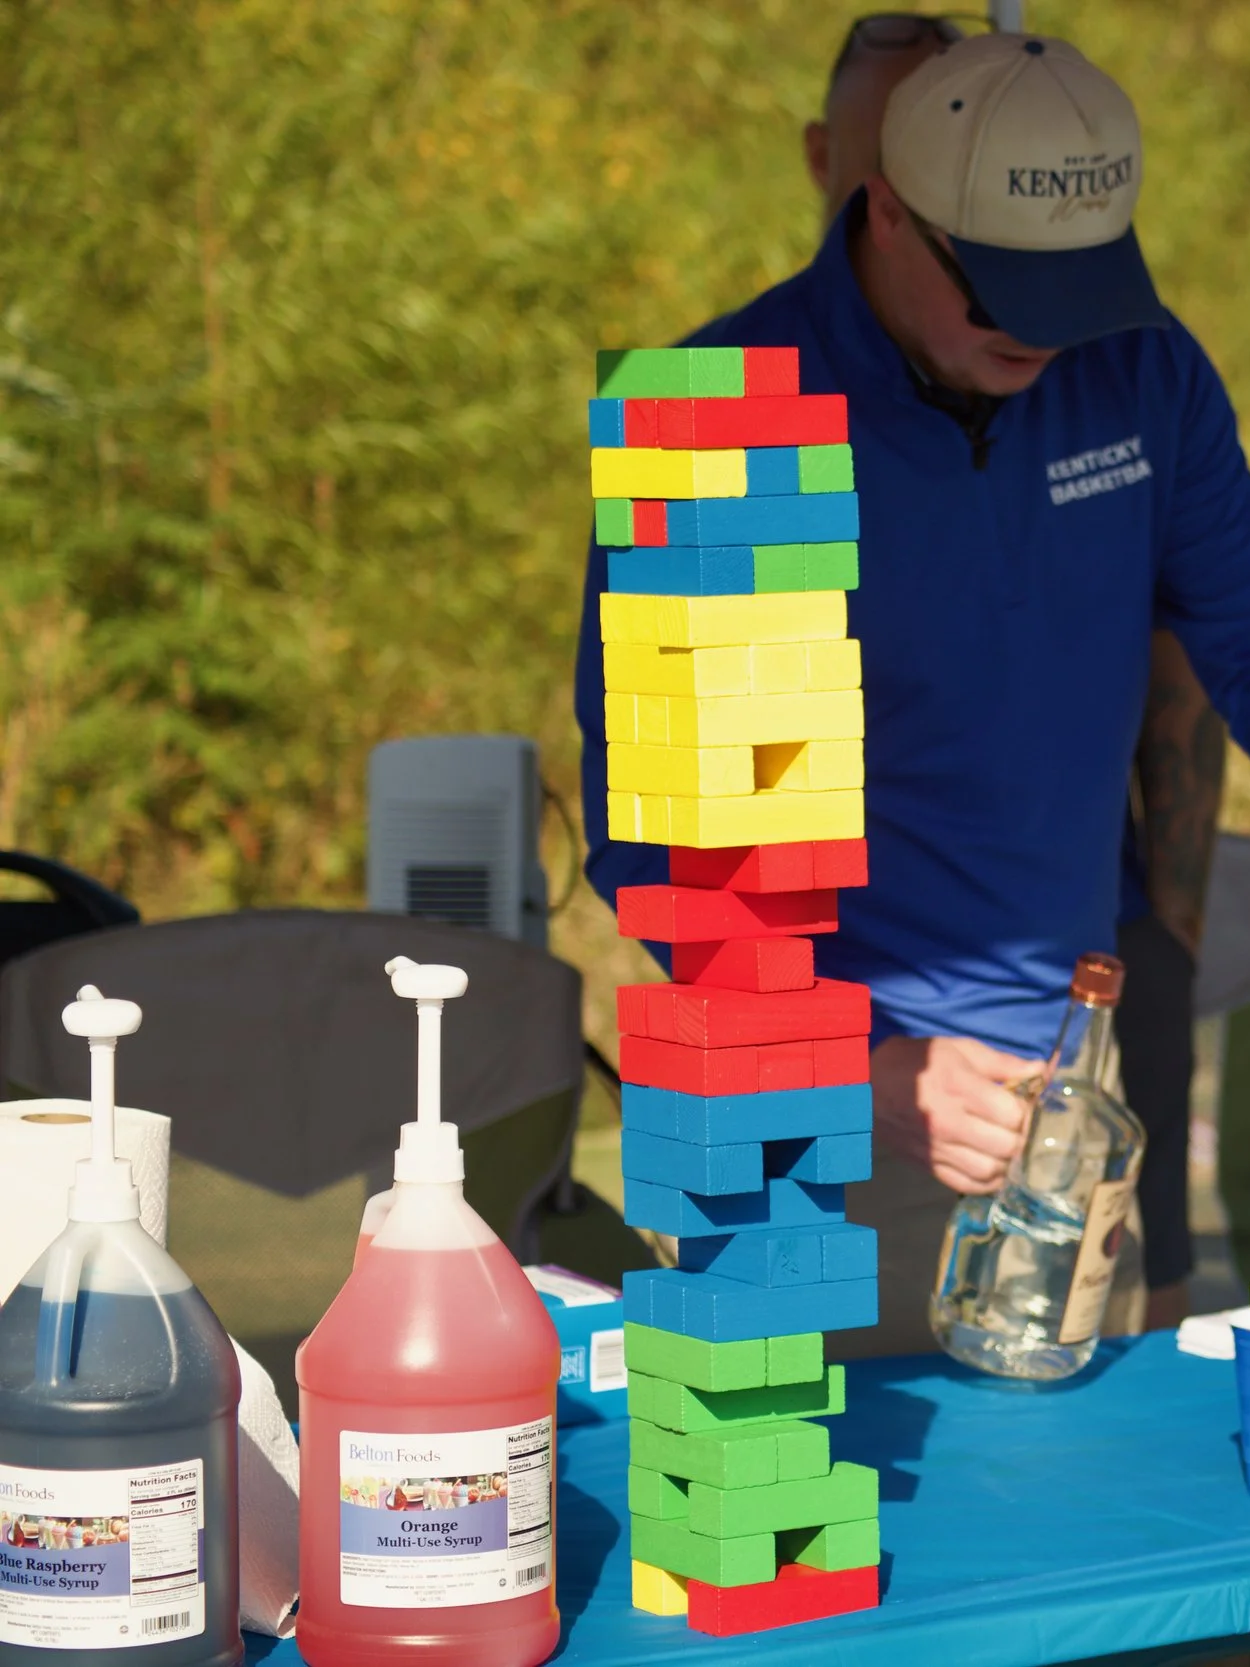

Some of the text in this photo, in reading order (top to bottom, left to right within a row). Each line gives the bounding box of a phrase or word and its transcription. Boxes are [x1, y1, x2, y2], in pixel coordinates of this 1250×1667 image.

[1008, 152, 1133, 198] KENTUCKY
[1046, 435, 1141, 482] KENTUCKY
[1049, 458, 1153, 506] BASKETBA
[508, 1432, 537, 1443] Nutrition
[349, 1443, 441, 1462] Belton Foods
[508, 1462, 532, 1471] Calories
[130, 1472, 197, 1487] Nutrition Facts
[15, 1483, 55, 1500] Foods
[130, 1499, 197, 1516] Calories 170
[401, 1519, 459, 1533] Orange
[377, 1535, 483, 1549] Multi-Use Syrup
[25, 1557, 107, 1575] Raspberry
[1, 1570, 99, 1590] Multi-Use Syrup
